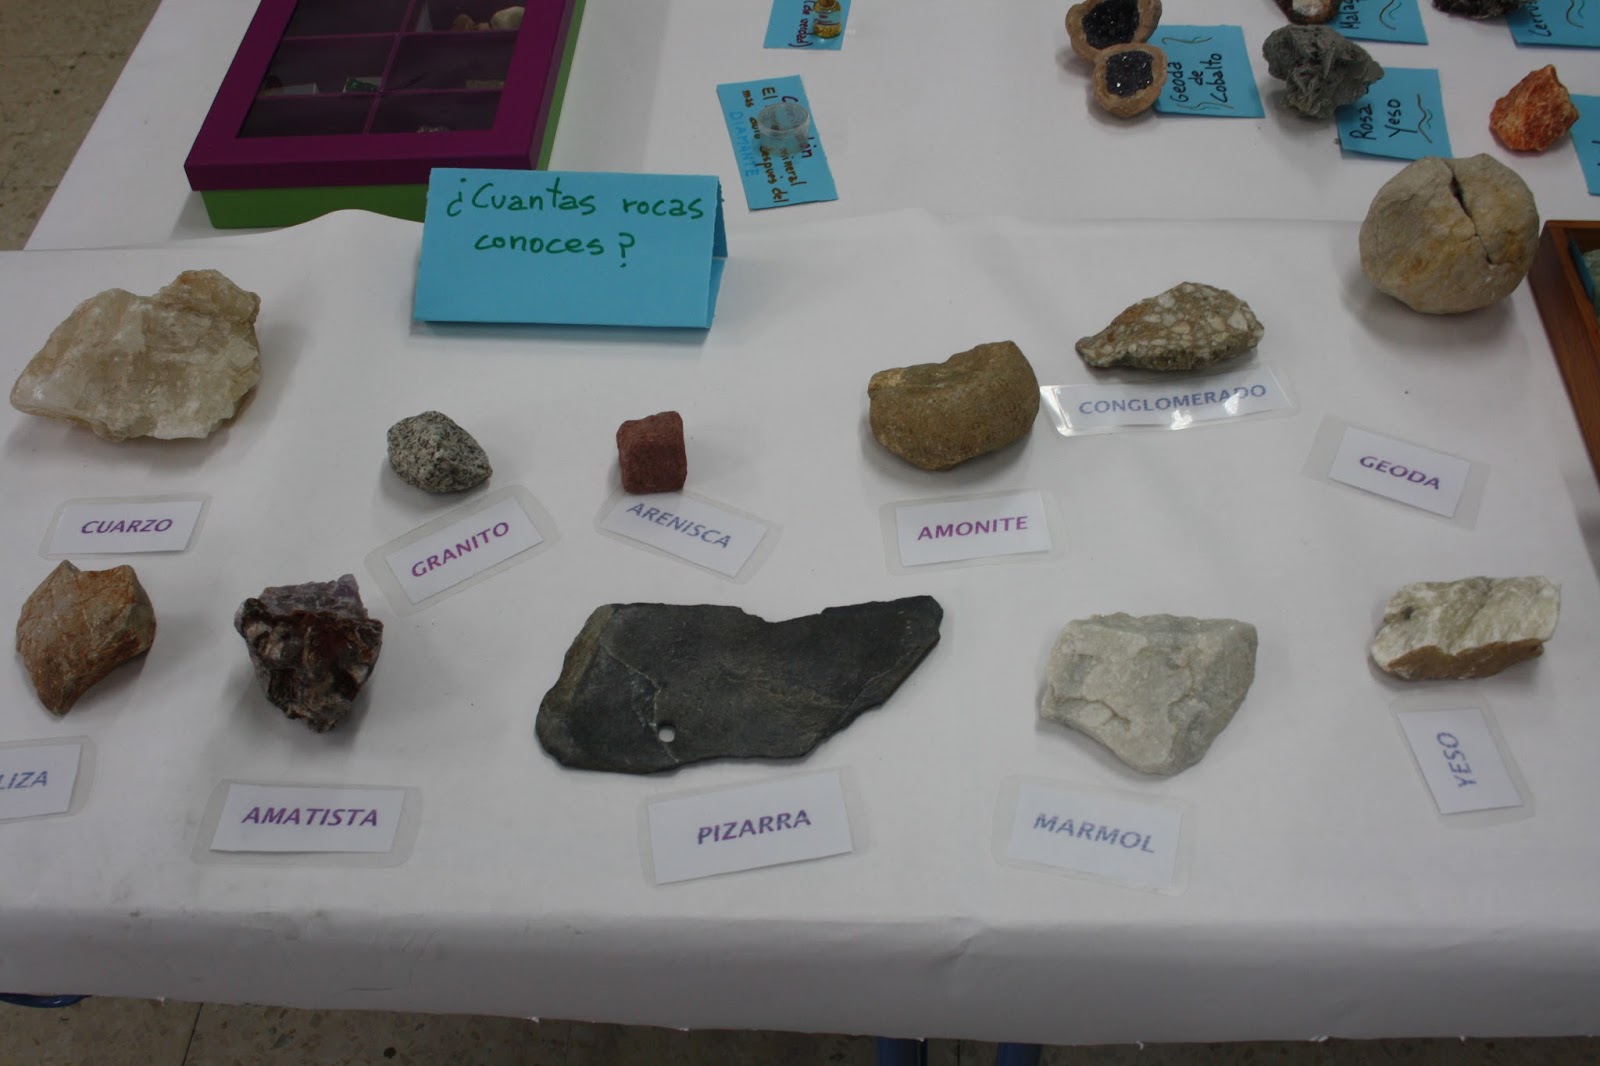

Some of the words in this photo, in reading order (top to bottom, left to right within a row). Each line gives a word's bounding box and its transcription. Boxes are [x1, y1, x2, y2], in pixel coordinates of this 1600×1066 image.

[762, 86, 778, 100] El
[1168, 62, 1190, 103] Geoda
[1188, 70, 1204, 86] de
[1200, 53, 1229, 103] Cobalto
[1350, 104, 1376, 141] Rosa
[729, 112, 760, 177] DIAMANTE
[446, 177, 597, 217] ¿Cuantas
[622, 197, 705, 219] rocas
[772, 188, 790, 203] del
[1078, 384, 1267, 415] CONGLOMERADO
[1359, 455, 1441, 490] GEODA
[80, 518, 174, 534] CUARZO
[626, 502, 732, 549] ARENISCA
[917, 515, 1029, 541] AMONITE
[411, 522, 510, 578] GRANITO
[1436, 732, 1478, 788] YESO
[241, 806, 379, 827] AMATISTA
[697, 809, 812, 845] PIZARRA
[1032, 812, 1156, 854] MARMOL
